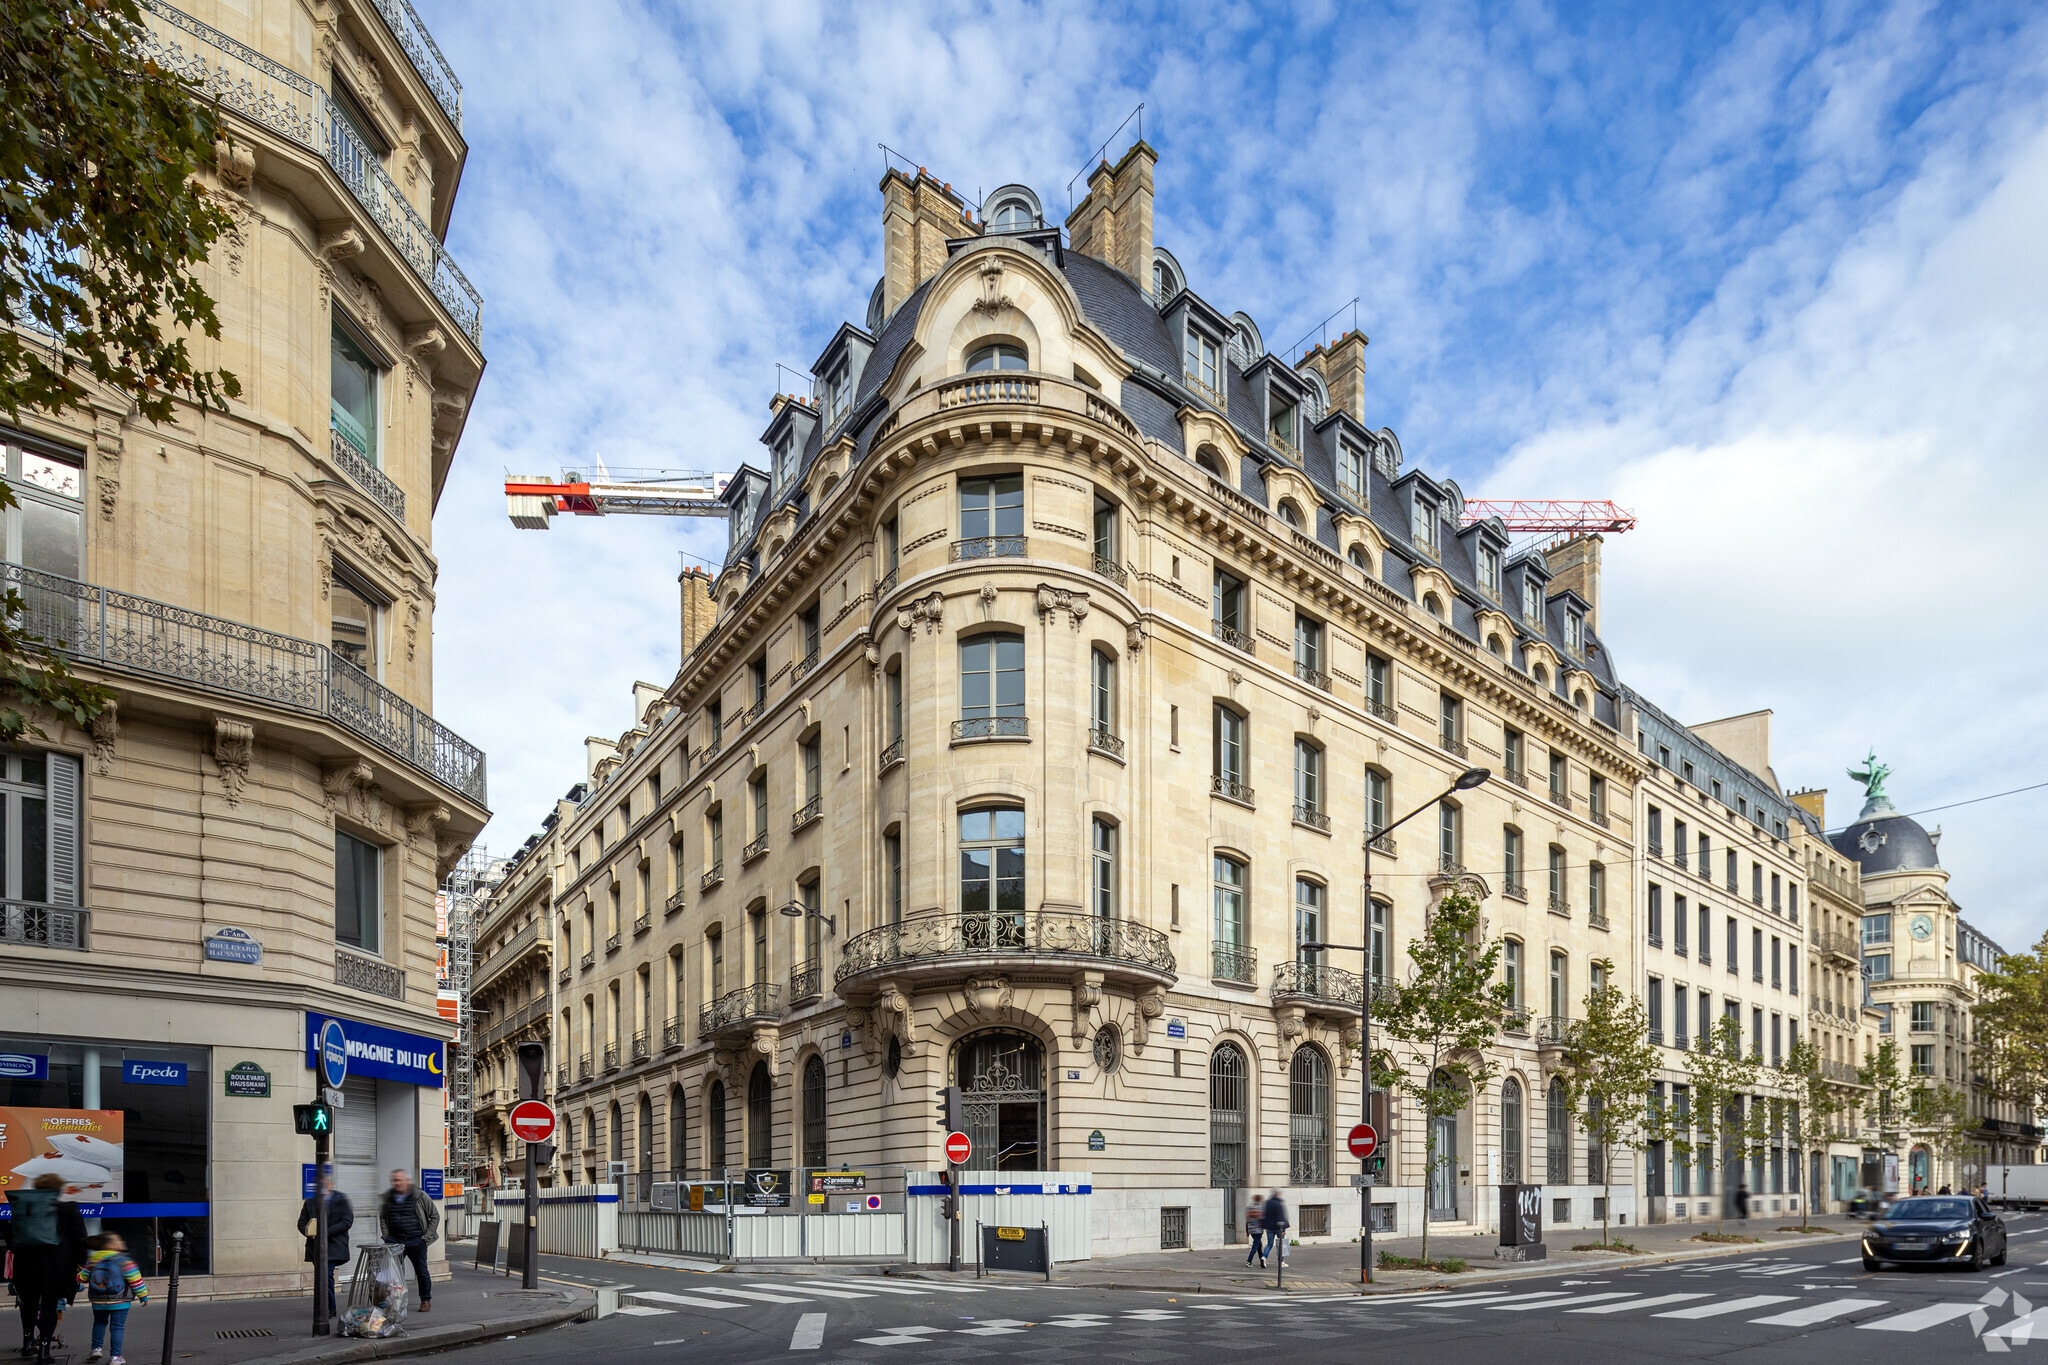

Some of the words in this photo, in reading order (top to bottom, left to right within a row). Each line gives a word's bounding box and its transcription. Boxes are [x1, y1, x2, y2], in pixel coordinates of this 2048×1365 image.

[210, 942, 257, 952] BOULEVARD
[210, 949, 257, 960] HAUSSMANN
[313, 1033, 320, 1050] L
[346, 1040, 395, 1064] MPAGNIE
[397, 1049, 412, 1066] DU
[413, 1053, 427, 1070] LIT
[132, 1064, 179, 1079] Epeda
[230, 1080, 266, 1088] HAUSSMANN
[50, 1118, 91, 1126] OFFRES
